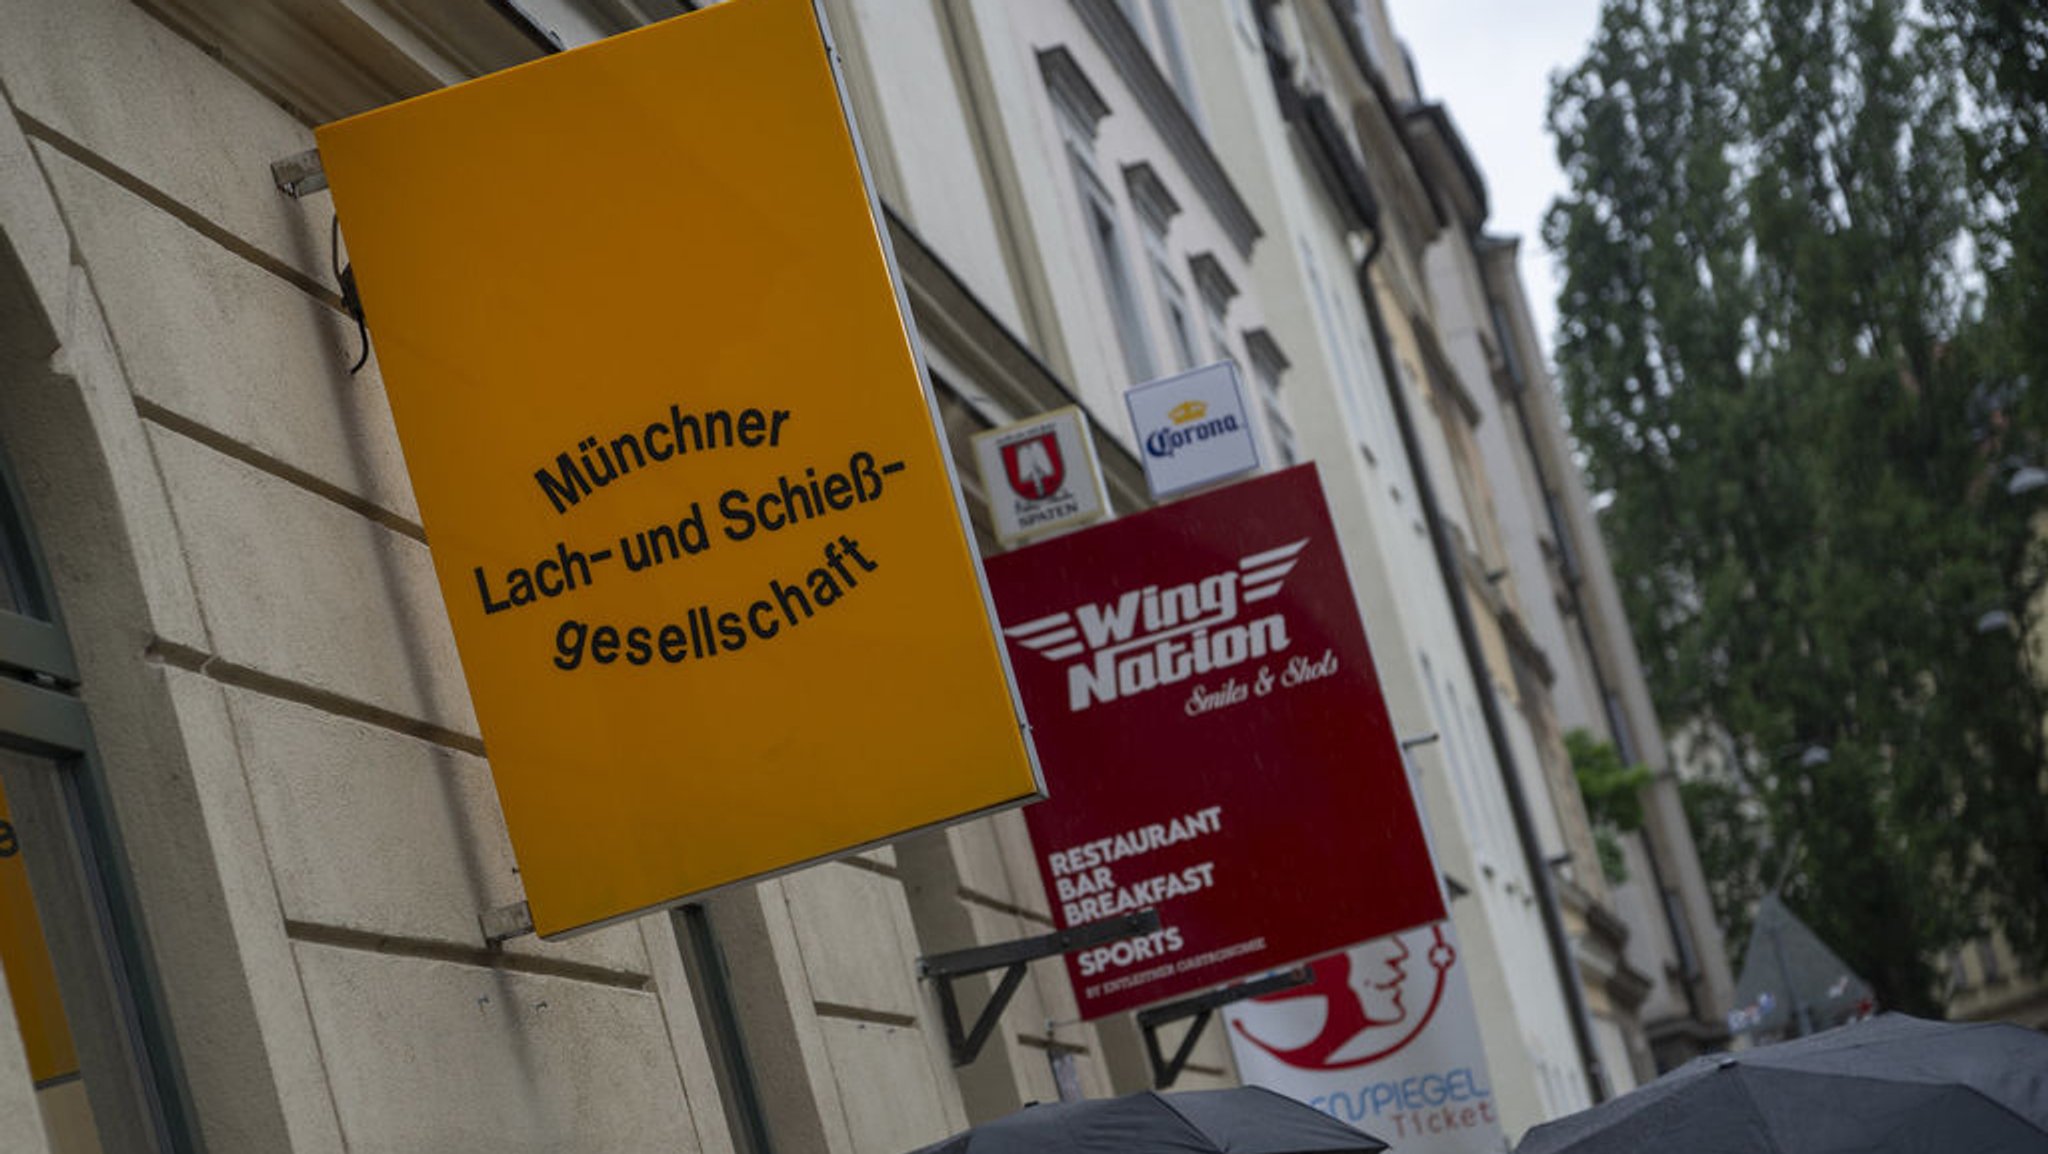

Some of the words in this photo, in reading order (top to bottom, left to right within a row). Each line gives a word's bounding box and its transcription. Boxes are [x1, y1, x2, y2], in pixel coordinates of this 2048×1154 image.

[534, 404, 791, 514] Münchner
[1146, 413, 1238, 458] Corona
[474, 542, 613, 615] Lach-
[619, 502, 710, 572] und
[718, 450, 906, 541] Schieß-
[1018, 502, 1078, 528] SPATEN
[553, 534, 878, 671] gesellschaft
[1075, 571, 1239, 650] Wing
[1067, 613, 1291, 712] Nation
[1184, 677, 1248, 717] Smiles
[1254, 665, 1275, 697] &
[1280, 648, 1338, 688] Shots
[1049, 806, 1222, 877] RESTAURANT
[1055, 866, 1116, 902] BAR
[1063, 862, 1215, 927] BREAKFAST
[1077, 926, 1184, 977] SPORTS
